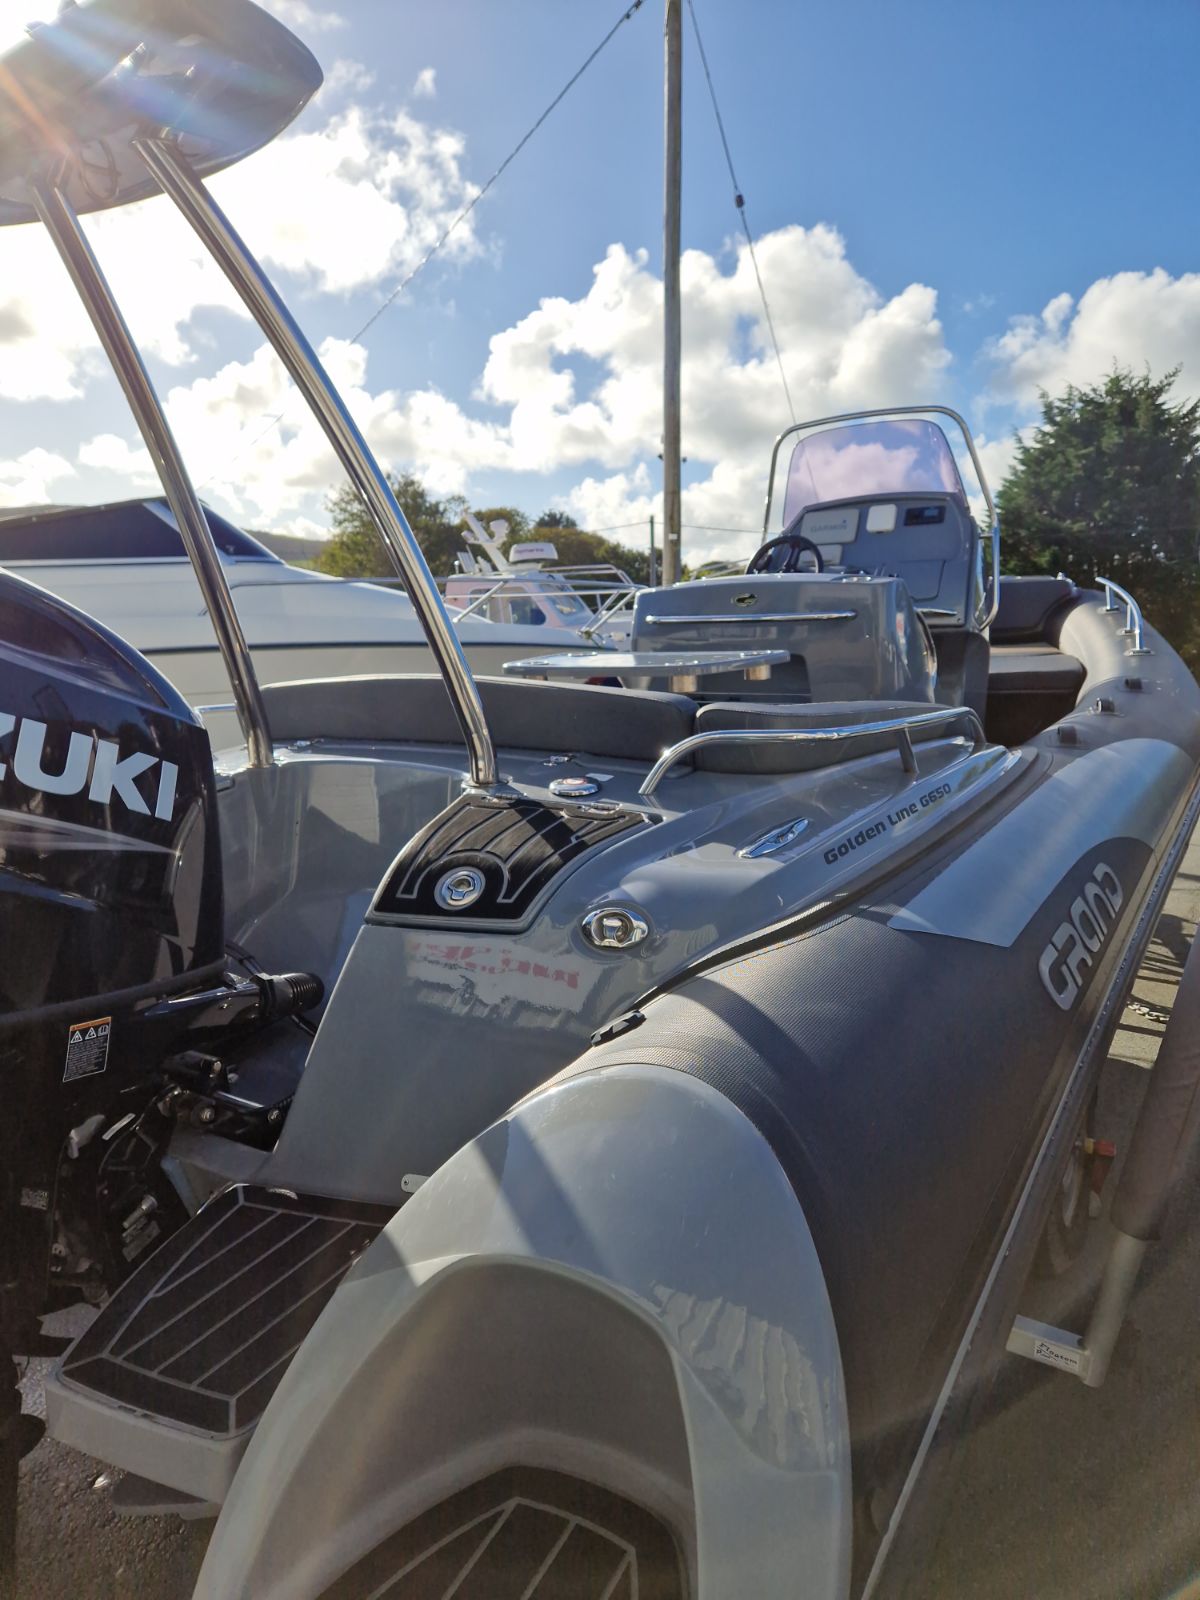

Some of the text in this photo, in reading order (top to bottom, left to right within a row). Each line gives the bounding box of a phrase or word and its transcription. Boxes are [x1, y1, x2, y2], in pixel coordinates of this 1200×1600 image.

[0, 712, 179, 822] UKI
[823, 820, 887, 865] Golden
[918, 783, 953, 809] G650
[1038, 862, 1124, 1011] GRAND
